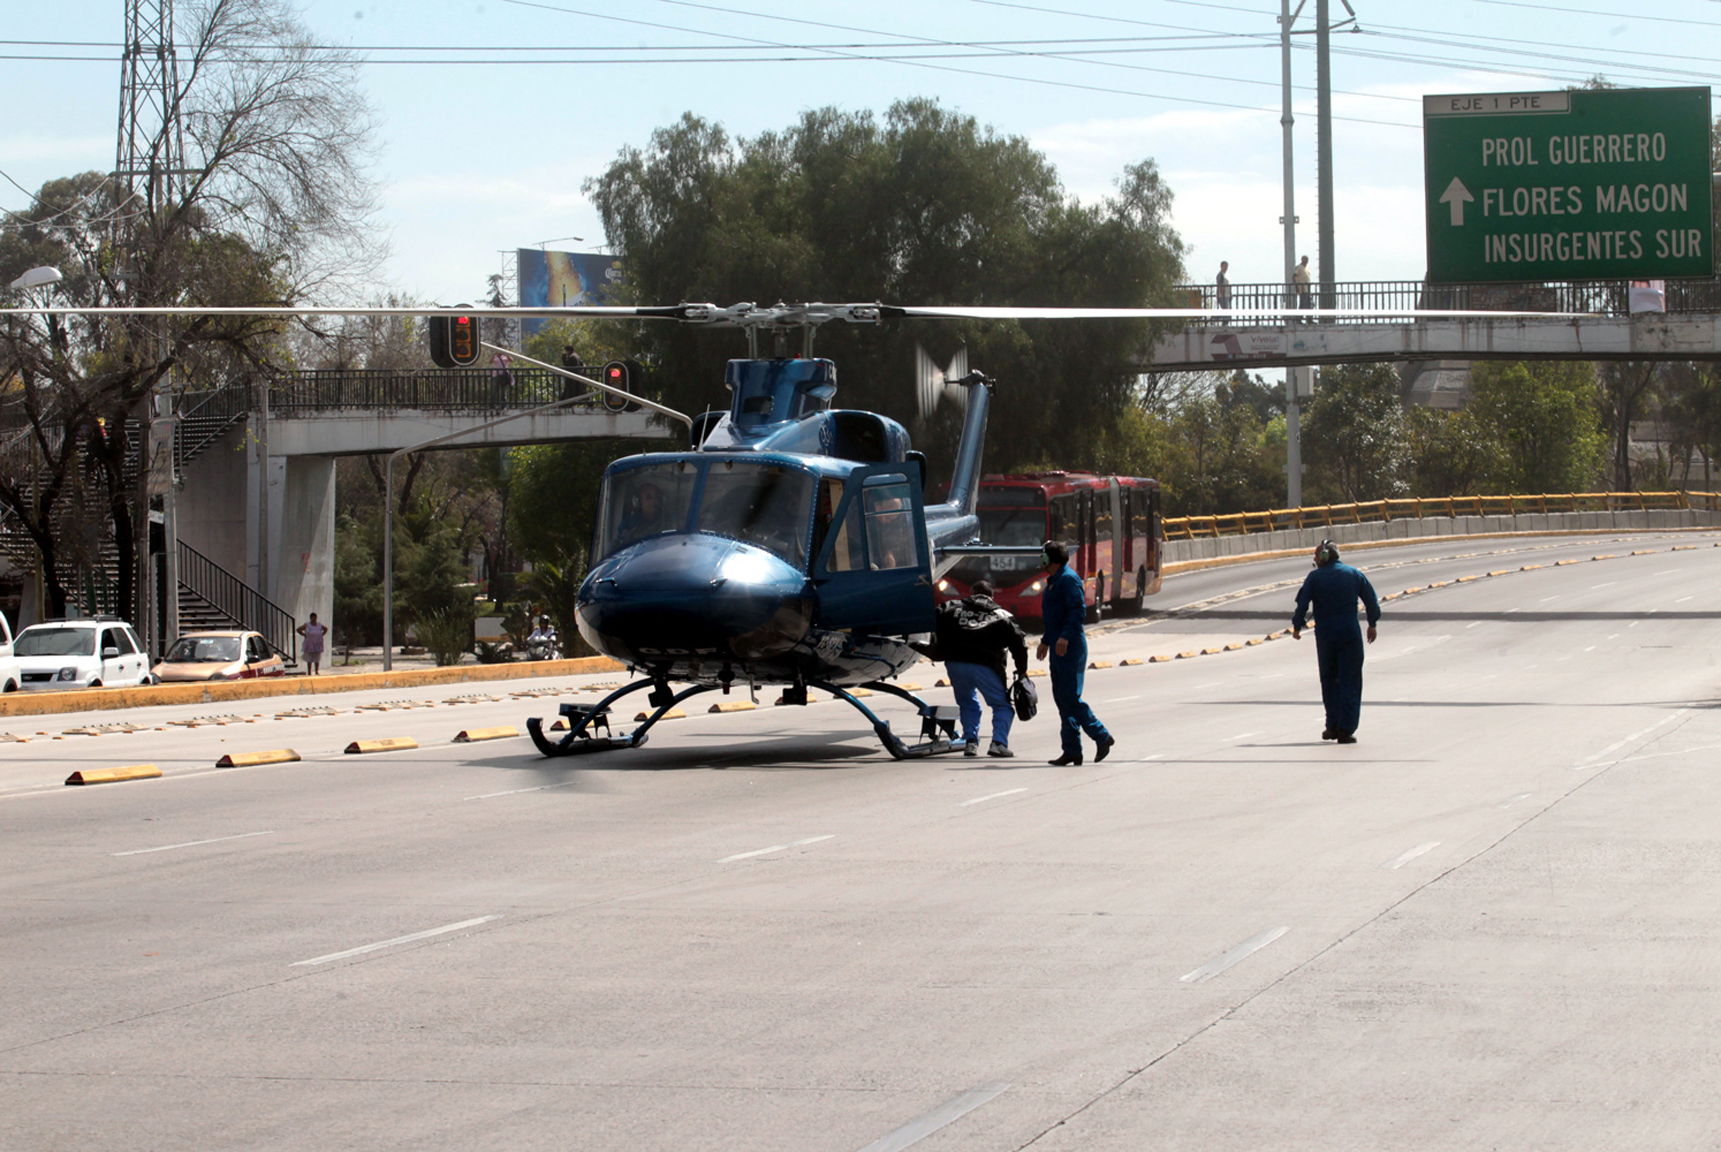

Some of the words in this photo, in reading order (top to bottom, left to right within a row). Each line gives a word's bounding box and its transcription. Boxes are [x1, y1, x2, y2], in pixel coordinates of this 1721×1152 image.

[1451, 97, 1483, 111] EJE
[1493, 97, 1499, 109] 1
[1510, 96, 1541, 109] PTE
[1482, 137, 1538, 166] PROL
[1549, 132, 1666, 165] GUERRERO
[1483, 185, 1583, 217] FLORES
[1596, 183, 1687, 213] MAGON
[1485, 230, 1643, 263] INSURGENTES
[1655, 229, 1701, 258] SUR
